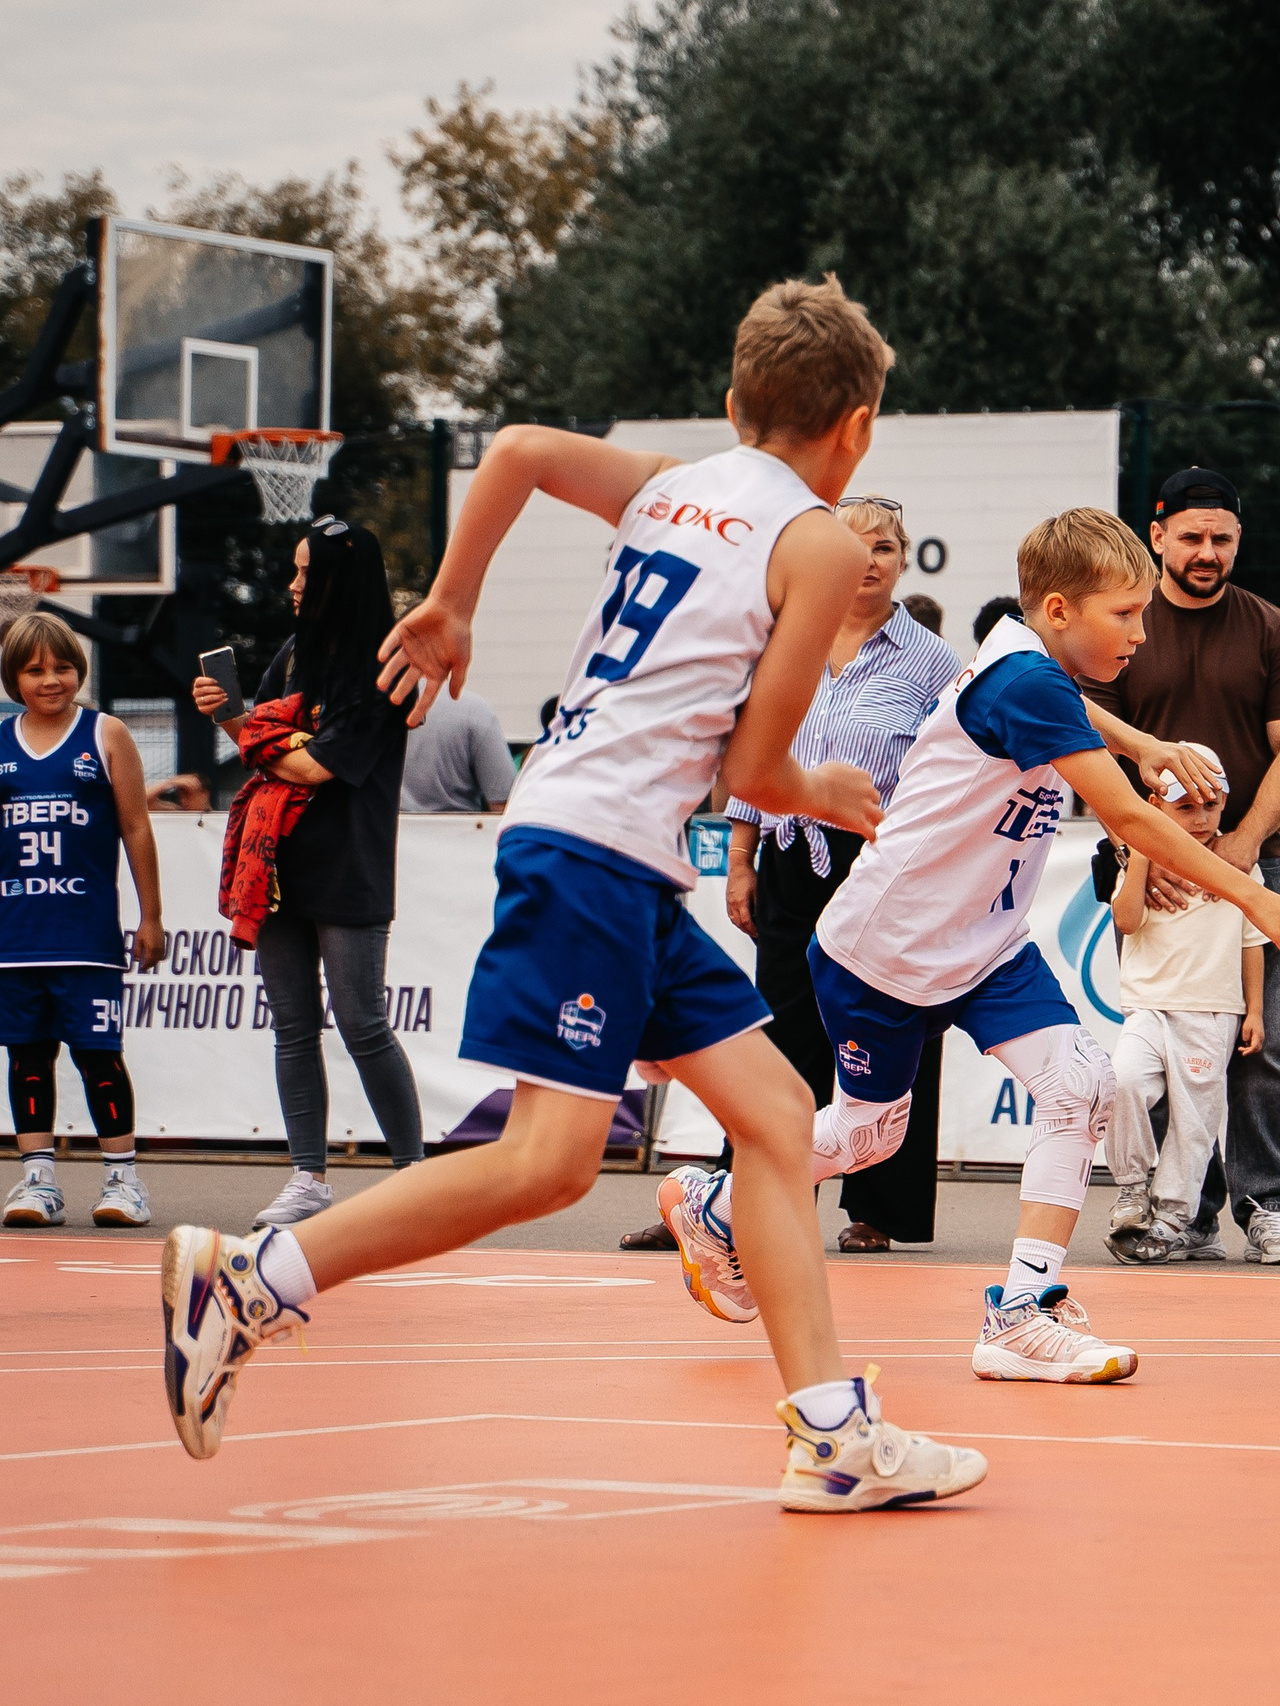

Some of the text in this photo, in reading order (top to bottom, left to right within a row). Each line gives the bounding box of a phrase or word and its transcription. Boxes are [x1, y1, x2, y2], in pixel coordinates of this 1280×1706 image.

[670, 503, 755, 547] DKC
[73, 769, 97, 779] ТВЕРЬ
[2, 801, 89, 828] ТВЕРЬ
[19, 831, 62, 867] 34
[26, 877, 86, 895] DKC
[92, 999, 121, 1033] 34
[557, 1024, 601, 1047] ТВЕРЬ
